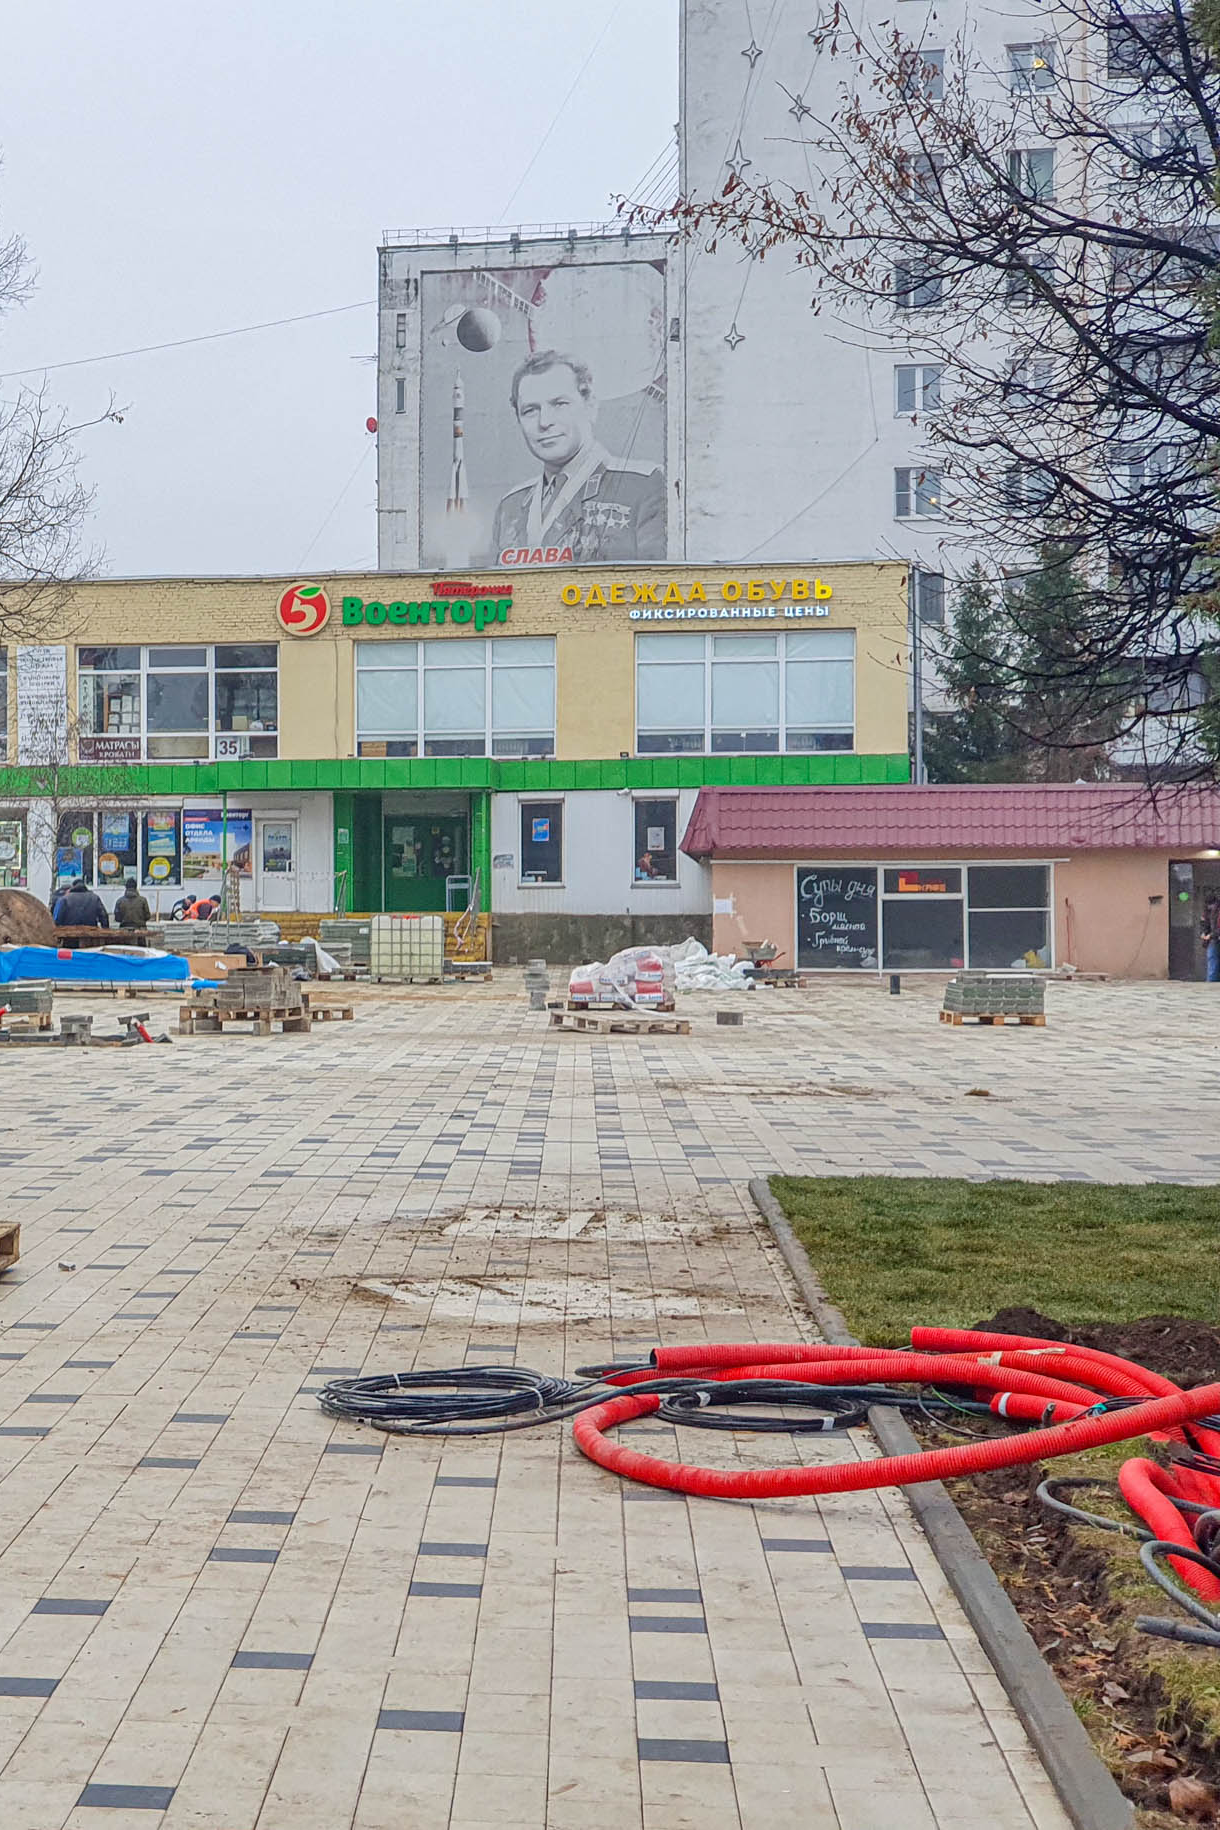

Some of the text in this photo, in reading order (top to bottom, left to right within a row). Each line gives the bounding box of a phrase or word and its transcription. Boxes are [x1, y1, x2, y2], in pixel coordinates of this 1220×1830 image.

[501, 547, 573, 566] СЛАВА
[561, 578, 833, 608] ОДЕЖДА ОБУВЬ
[342, 597, 513, 632] Военторг
[629, 605, 829, 620] ФИКСИРОВАННЫЕ ЦЕНЫ
[95, 741, 140, 750] МАТРАСЫ
[219, 740, 238, 755] 35
[800, 874, 876, 907] Супы дня
[809, 907, 848, 925] Борщ
